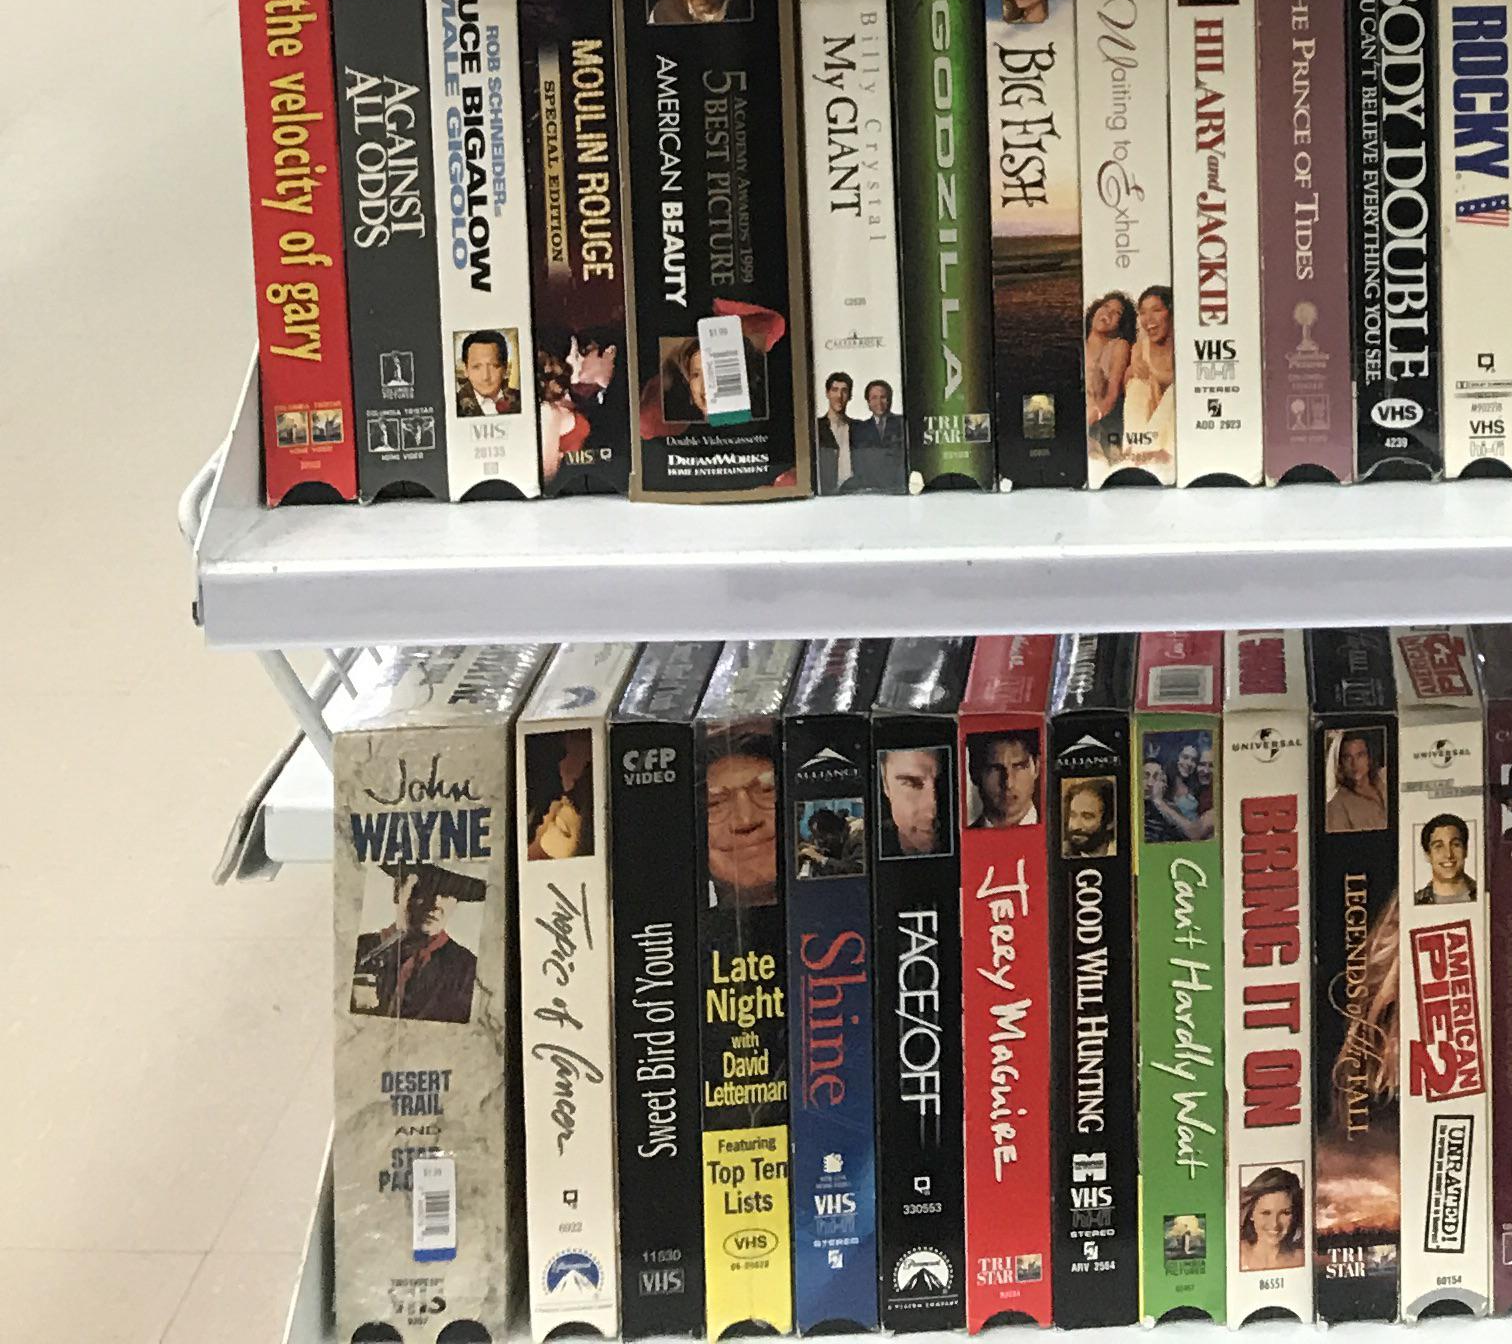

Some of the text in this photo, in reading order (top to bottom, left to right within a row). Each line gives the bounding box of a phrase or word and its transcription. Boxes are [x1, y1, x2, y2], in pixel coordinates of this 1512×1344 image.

[261, 66, 324, 216] velocity
[383, 74, 425, 239] AGAINST
[573, 39, 614, 281] MOULIN ROUGE
[655, 53, 687, 308] AMERICAN BEAUTY
[1193, 17, 1229, 326] HILARY and JACKIE
[1451, 5, 1510, 180] ROCKY
[277, 229, 332, 268] of
[461, 85, 492, 292] BIGALOW
[928, 0, 964, 403] GODZILLA
[1383, 145, 1431, 383] DOUBLE
[265, 280, 323, 362] gary
[351, 807, 492, 862] WAYNE
[631, 922, 677, 1158] Sweet Bird of Youth
[706, 988, 785, 1029] Night
[712, 952, 776, 985] Late
[801, 928, 868, 1110] Shine
[1074, 868, 1105, 1135] GOOD WILL HUNTING
[1241, 794, 1301, 1129] BRING IT ON
[723, 1050, 770, 1079] David
